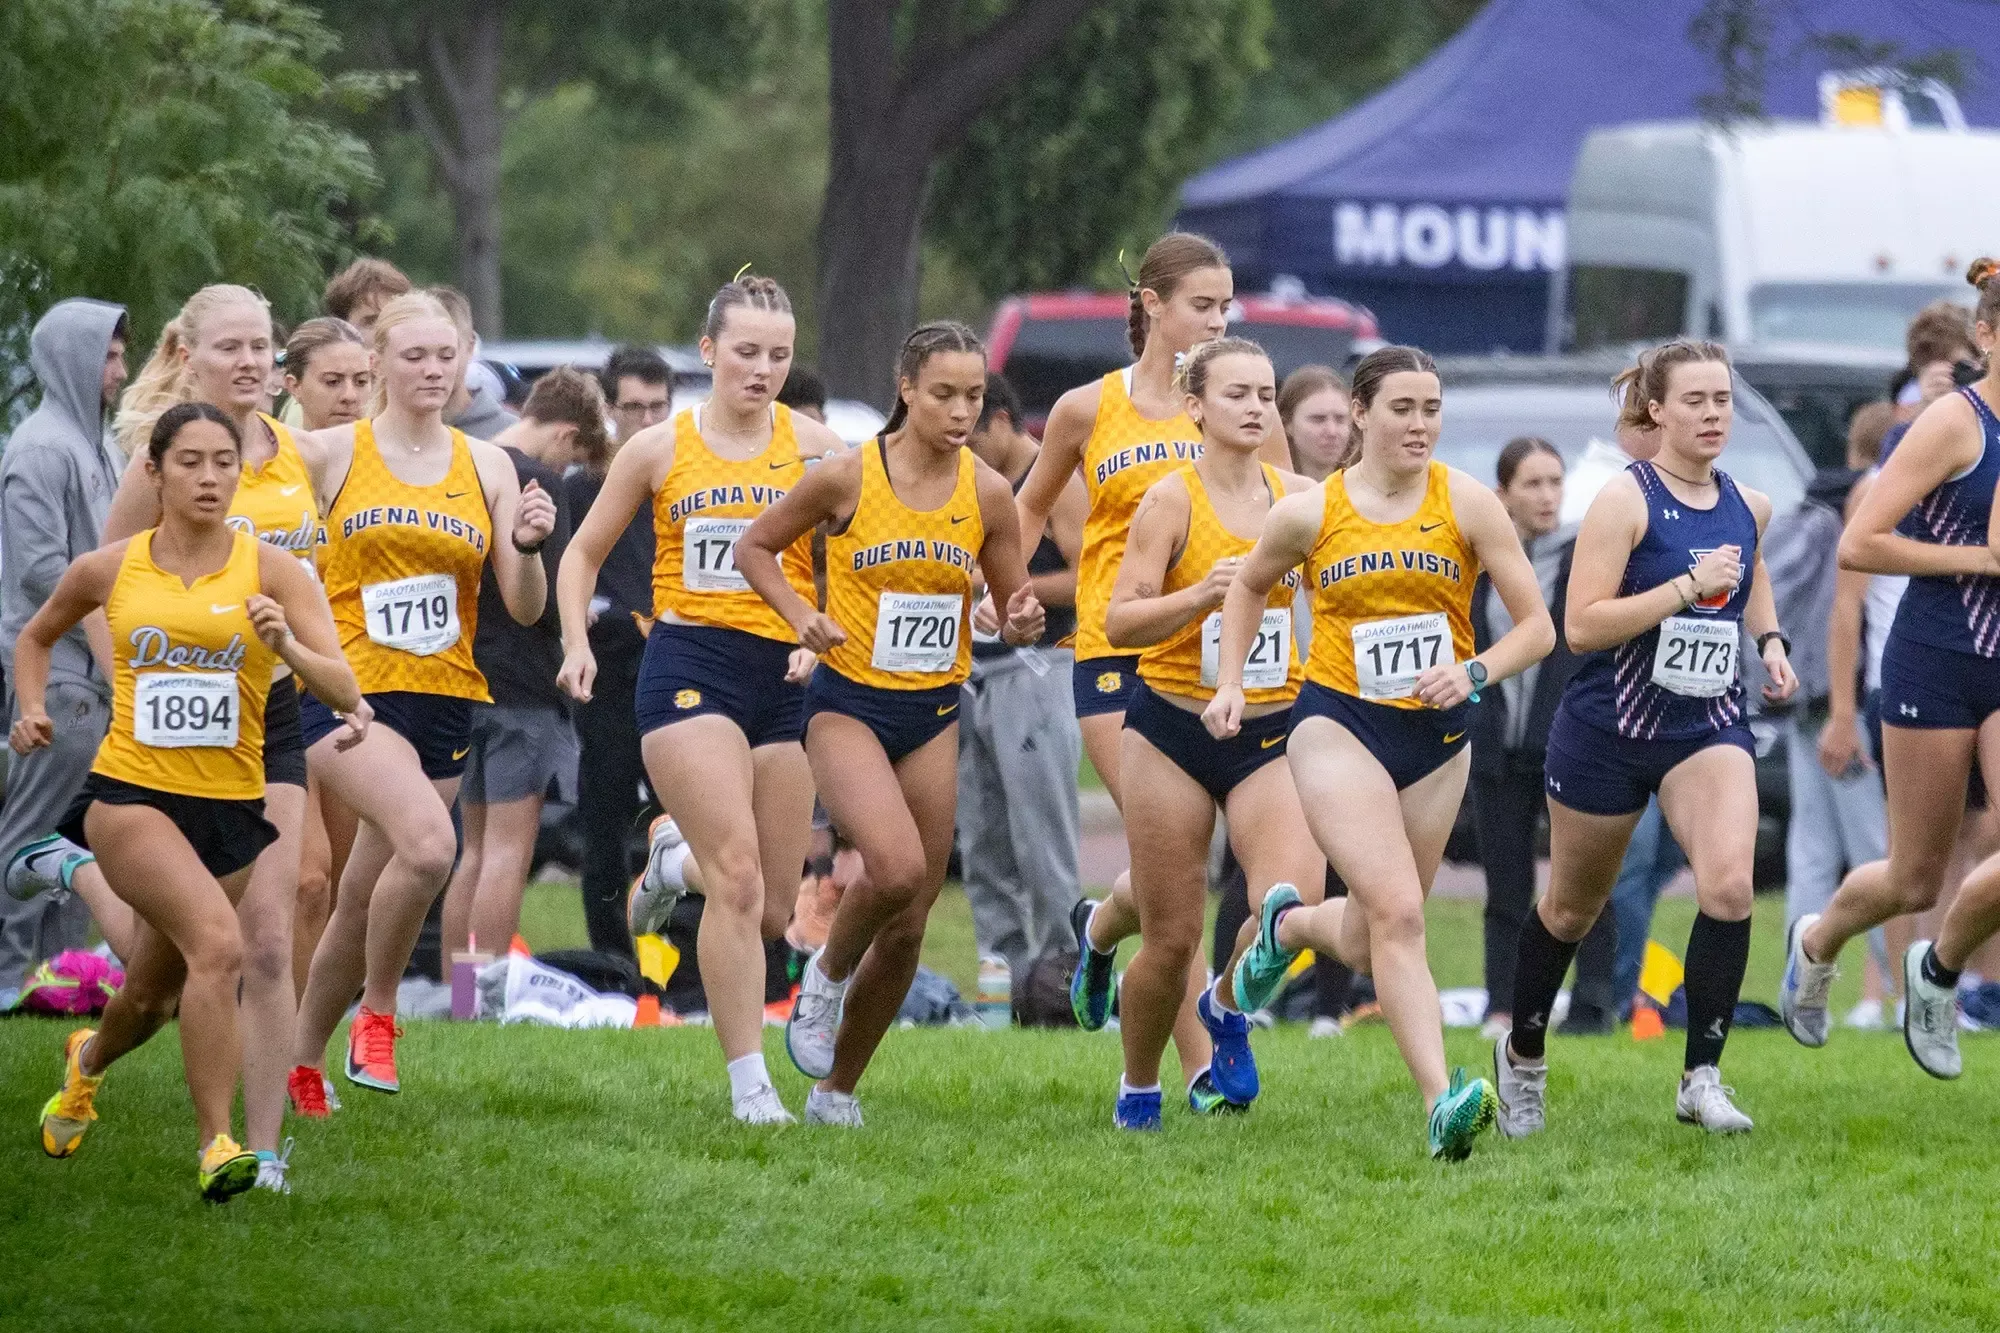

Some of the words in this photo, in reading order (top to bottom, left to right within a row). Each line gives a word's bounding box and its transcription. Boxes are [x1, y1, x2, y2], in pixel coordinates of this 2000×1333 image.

[1334, 202, 1566, 270] MOUN
[1096, 442, 1168, 486] BUENA
[669, 486, 744, 523] BUENA
[343, 508, 419, 538] BUENA
[427, 511, 484, 553] VISTA
[693, 539, 738, 571] 17
[854, 540, 926, 571] BUENA
[1320, 552, 1395, 589] BUENA
[1401, 551, 1461, 583] VISTA
[378, 596, 448, 636] 1719
[888, 616, 955, 649] 1720
[128, 625, 247, 673] Dordt
[1367, 634, 1442, 676] 1717
[1664, 637, 1731, 675] 2173
[146, 695, 232, 730] 1894
